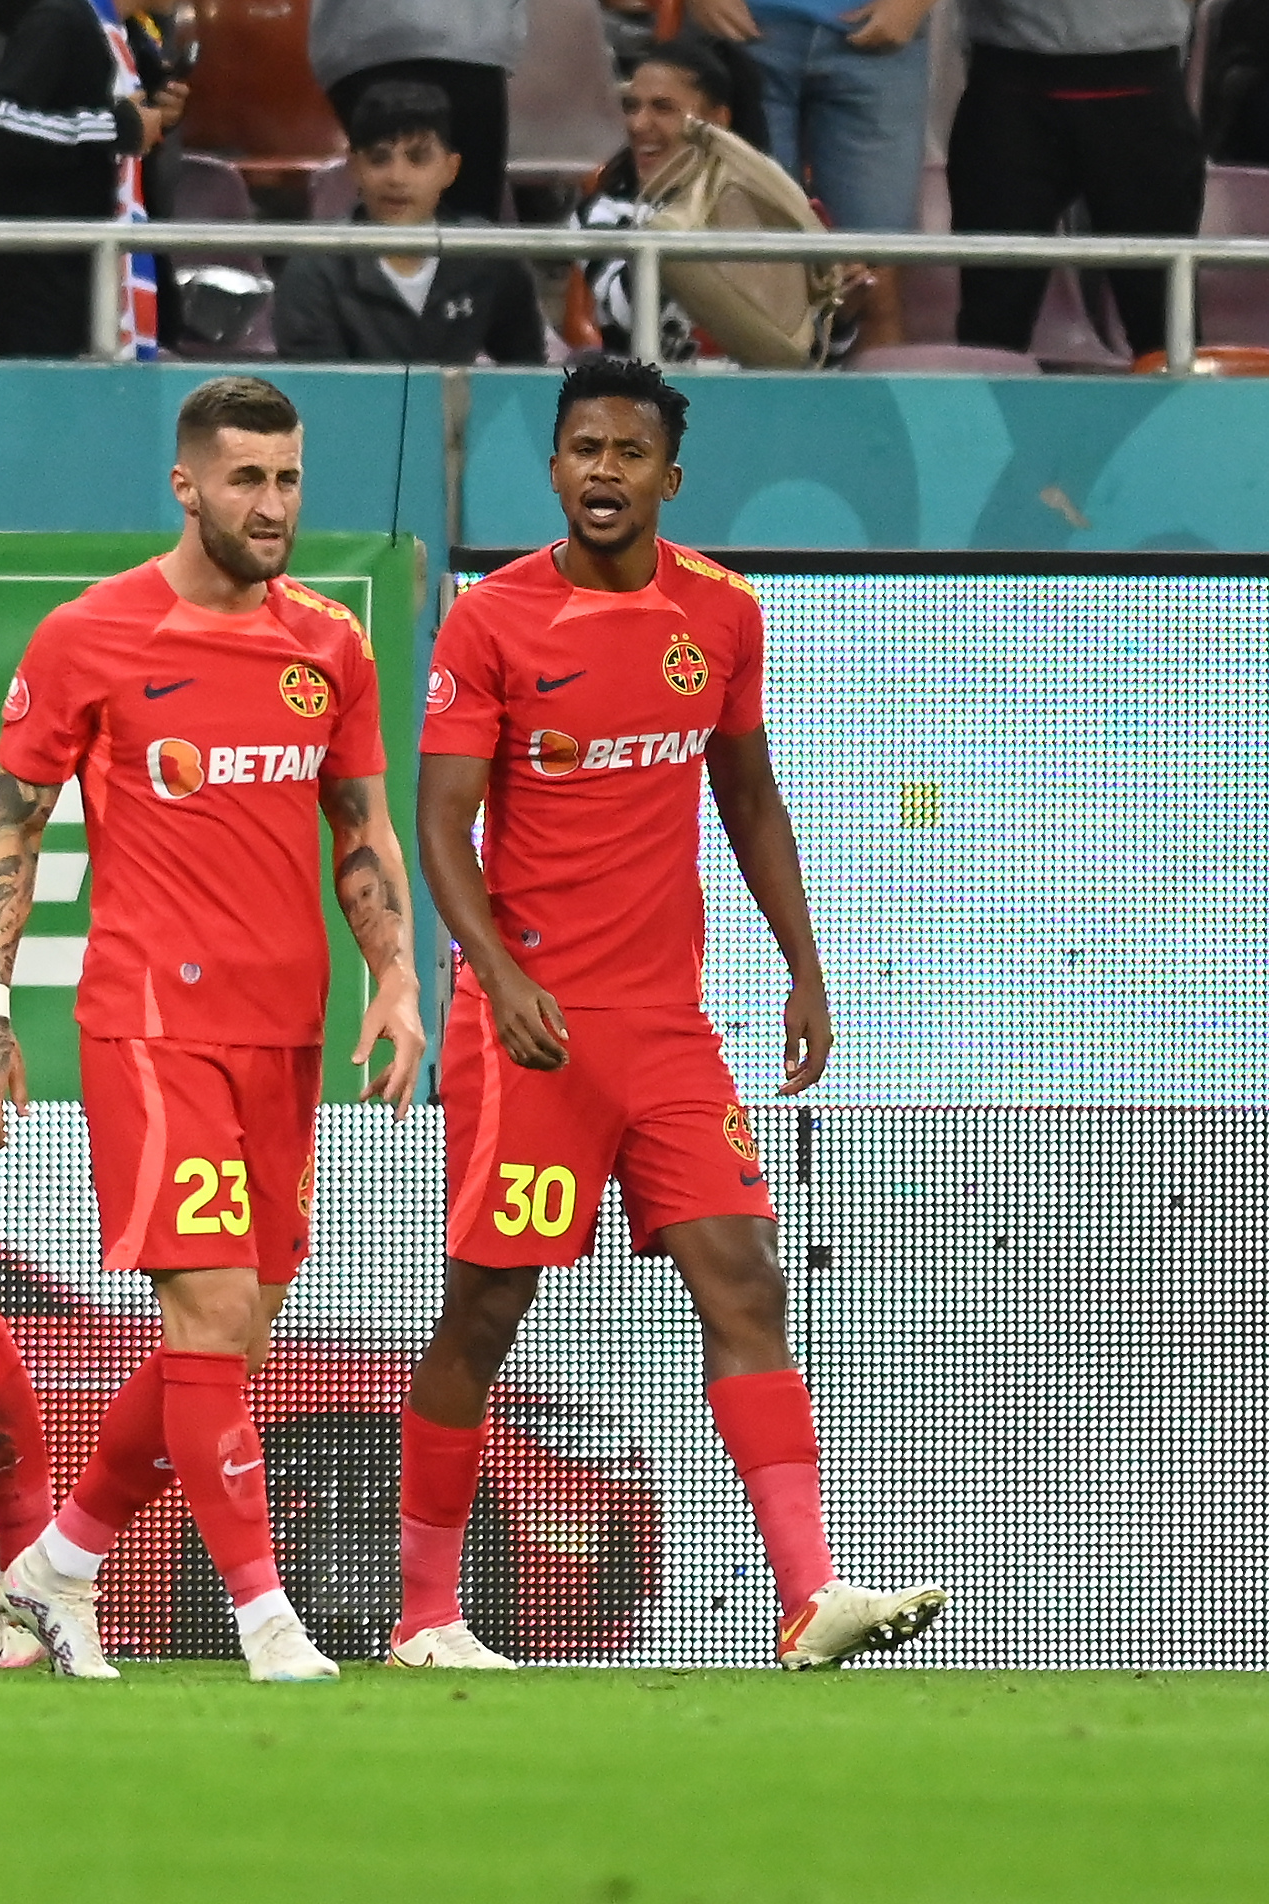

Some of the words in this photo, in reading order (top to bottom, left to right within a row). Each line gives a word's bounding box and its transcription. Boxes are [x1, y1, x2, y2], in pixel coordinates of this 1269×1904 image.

[208, 744, 329, 784] BETAN
[582, 723, 717, 769] BETAN
[173, 1157, 252, 1237] 23
[492, 1163, 577, 1237] 30
